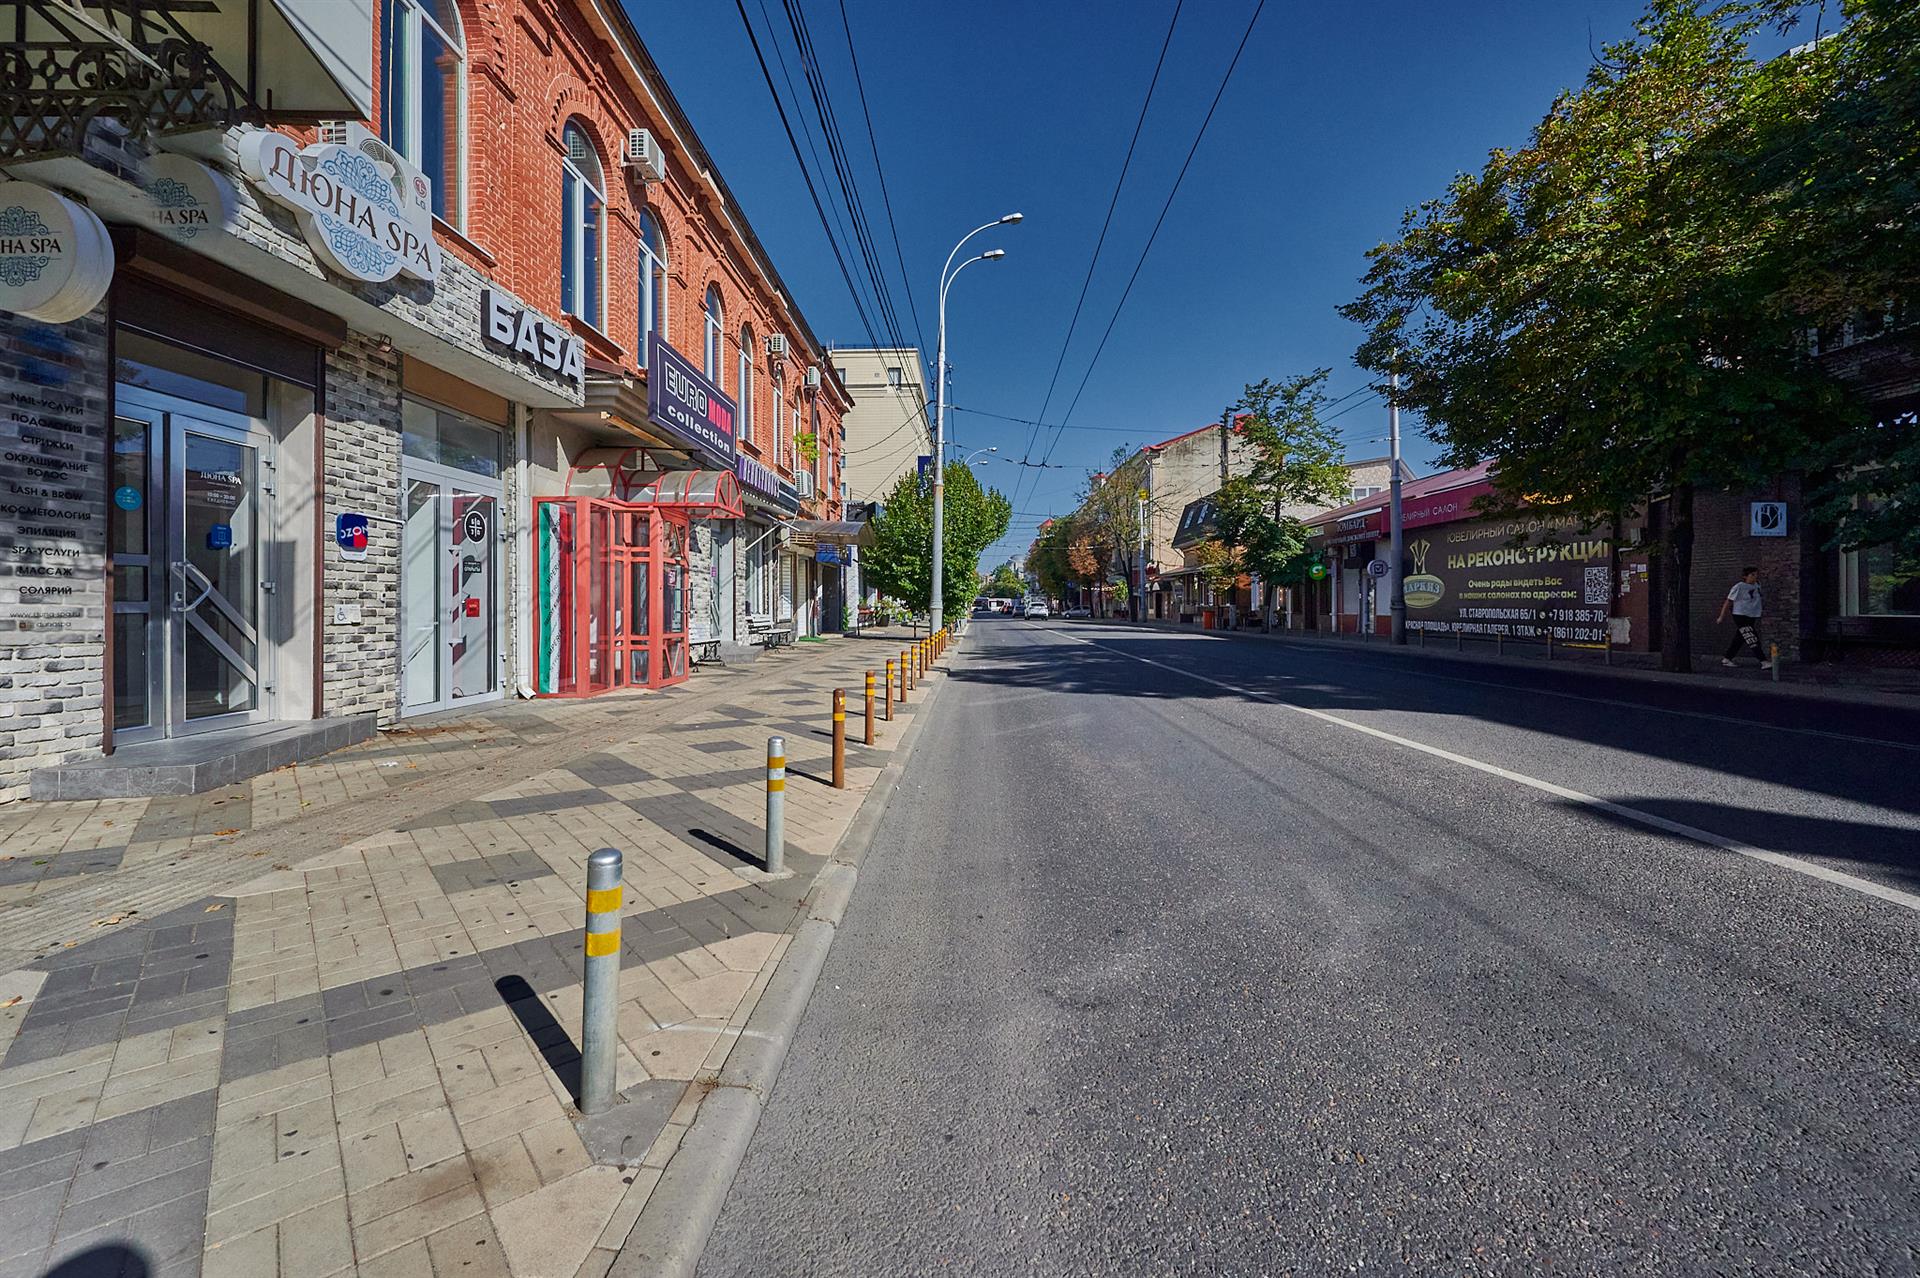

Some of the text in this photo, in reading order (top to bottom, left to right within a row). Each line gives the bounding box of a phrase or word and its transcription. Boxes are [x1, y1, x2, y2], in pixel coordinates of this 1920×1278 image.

[179, 209, 209, 224] SPA
[268, 146, 433, 273] ДЮНА SPA
[30, 238, 62, 253] SPA
[489, 290, 584, 384] БАЗА
[664, 361, 707, 417] EURO
[10, 392, 84, 415] NAIL-УСЛУГИ
[667, 405, 730, 453] collection
[21, 435, 74, 451] СТРИЖКИ
[4, 452, 89, 472] ОКРАШИВАНИЕ
[27, 467, 69, 480] ВОЛОС
[228, 475, 242, 485] SPA
[10, 485, 84, 500] LASH & BROW
[0, 504, 91, 520] КОСМЕТОЛОГИЯ
[1432, 502, 1458, 515] САЛОН
[17, 526, 76, 538] ЭПИЛЯЦИЯ
[1447, 526, 1505, 543] ЮВЕЛИРНЫЙ
[12, 545, 80, 557] SPA-УСЛУГИ
[1447, 554, 1466, 569] НА
[19, 566, 73, 576] МАССАЖ
[19, 585, 72, 595] СОЛЯРИЙ
[1468, 577, 1563, 589] Очень рады видеть Вас
[1521, 591, 1532, 599] по
[1468, 608, 1519, 620] СТАВРОПОЛЬСКАЯ
[1519, 608, 1536, 620] 65/1
[1516, 625, 1536, 637] ЭТАЖ
[1553, 626, 1573, 639] (861)
